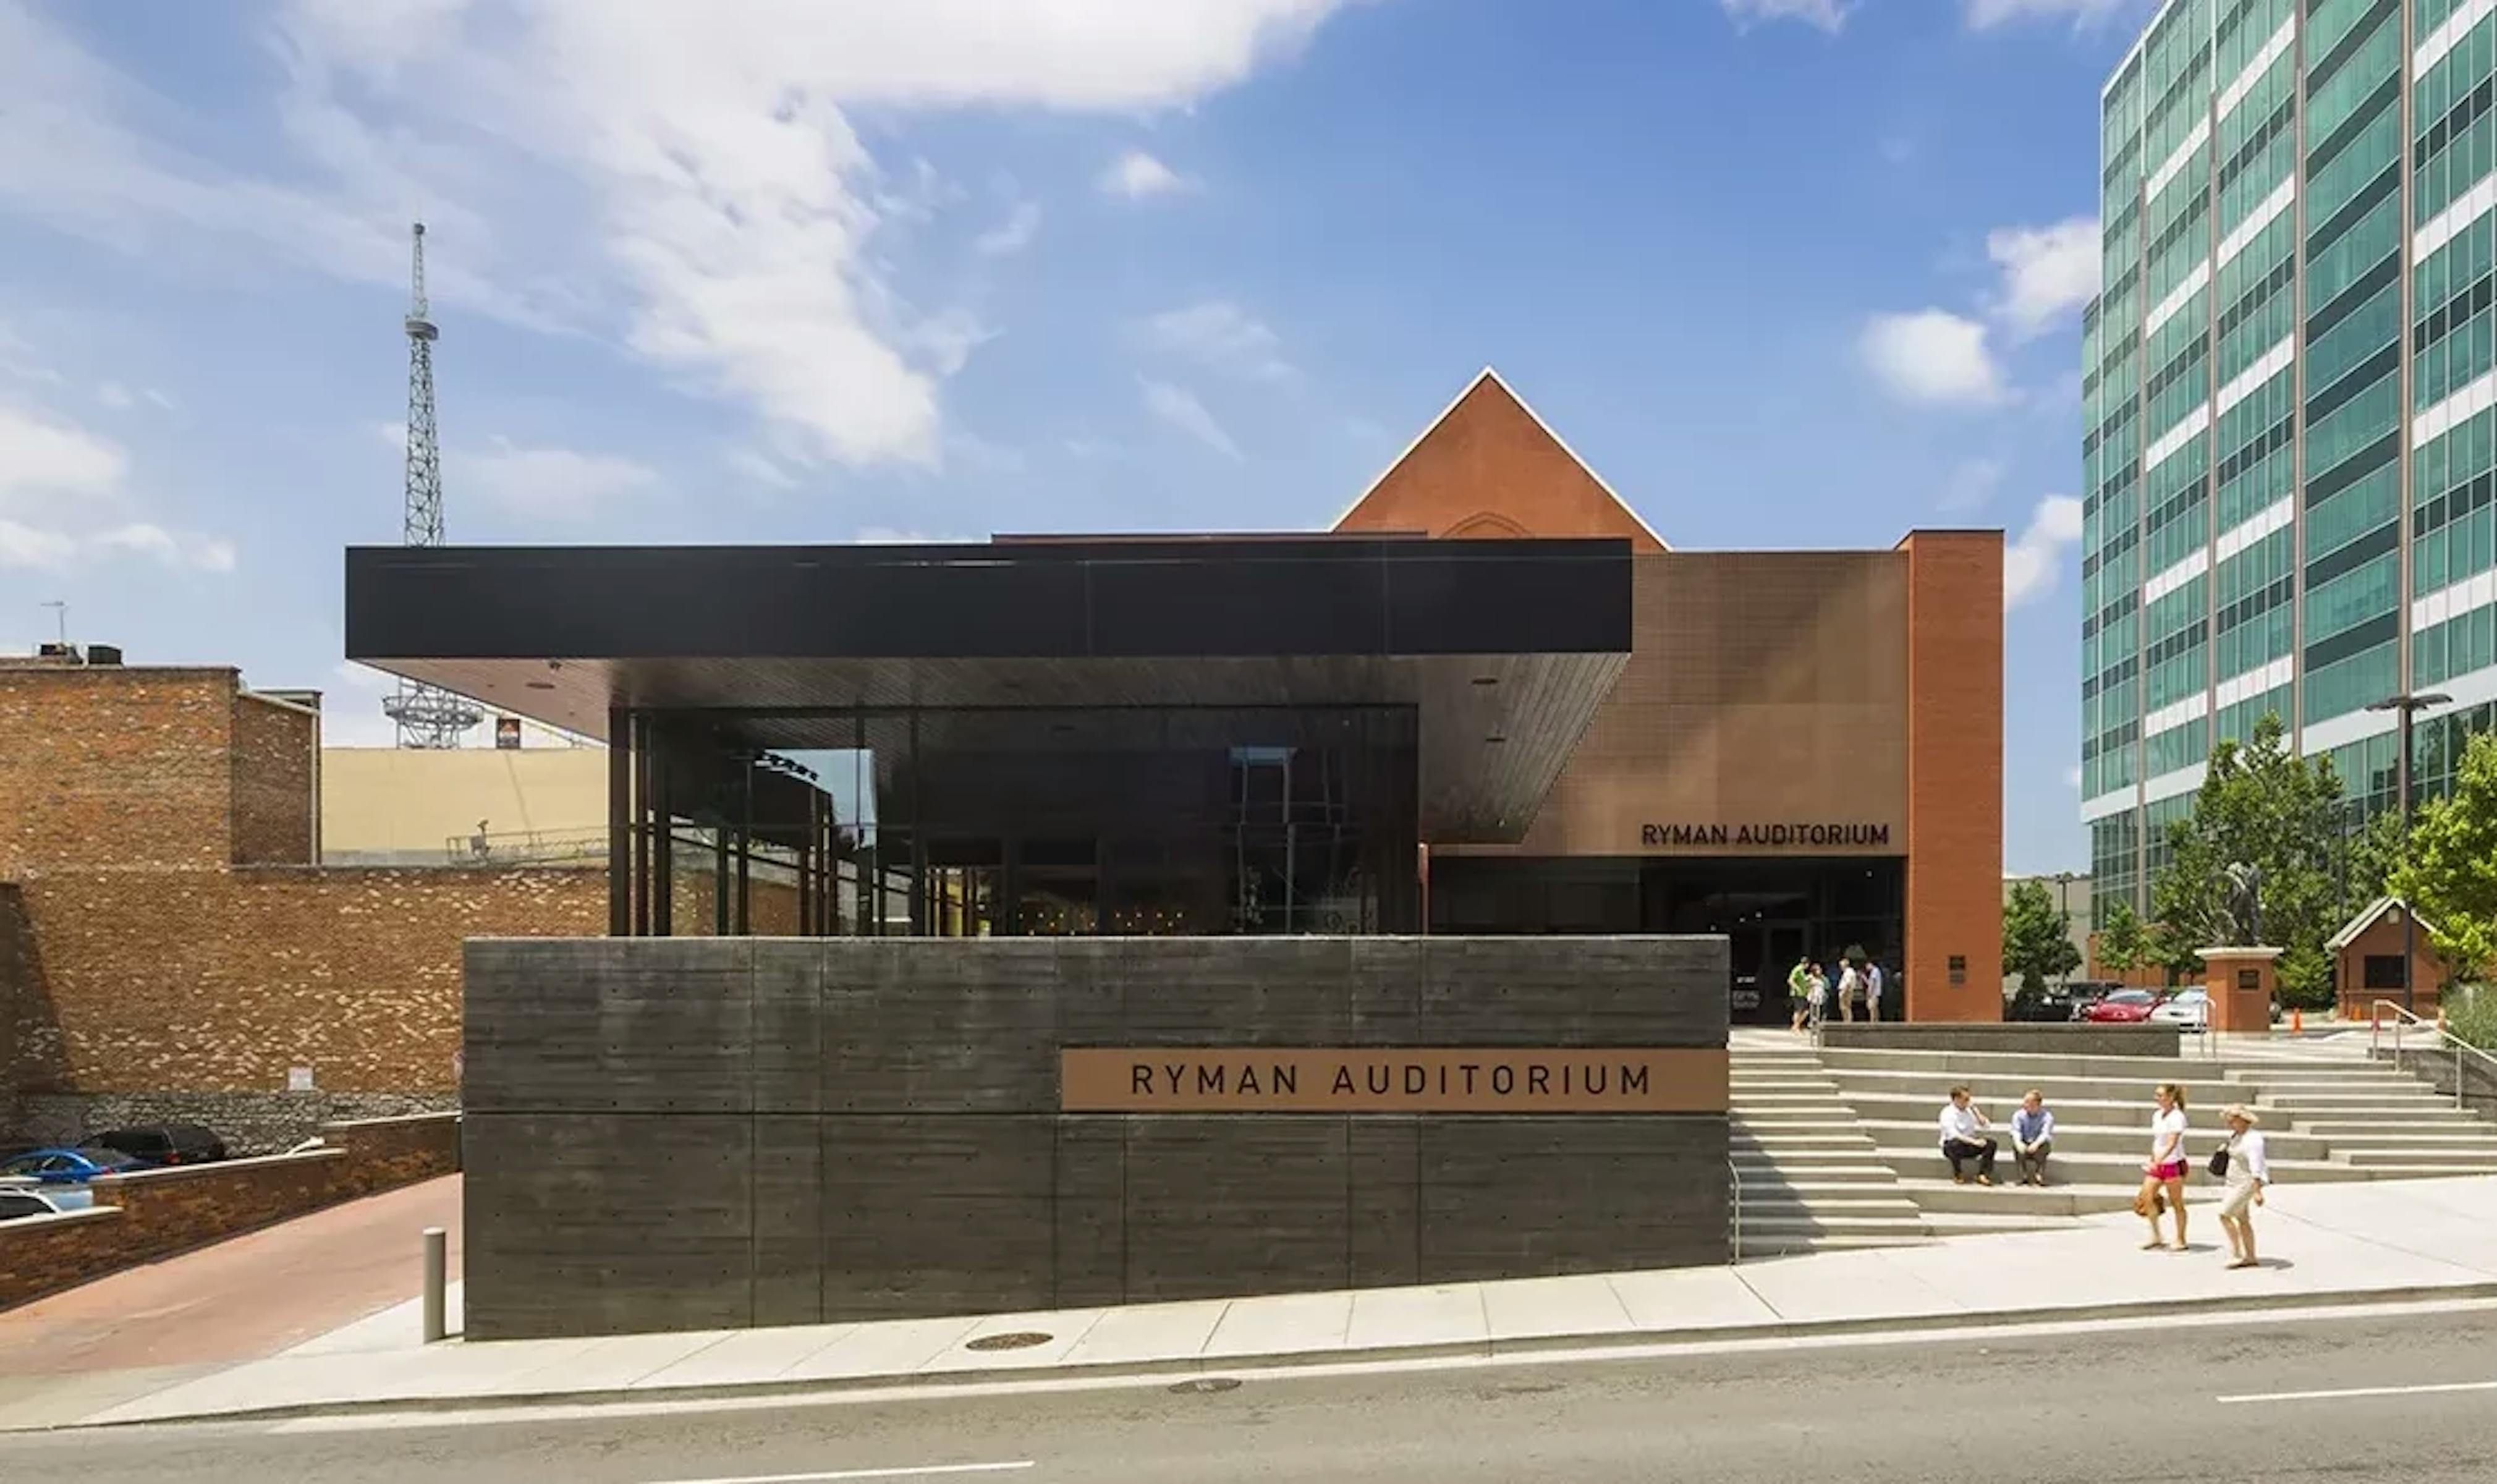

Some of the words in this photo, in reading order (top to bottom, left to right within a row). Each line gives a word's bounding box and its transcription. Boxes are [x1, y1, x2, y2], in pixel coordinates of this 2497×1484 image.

[1642, 824, 1728, 845] RYMAN
[1736, 824, 1888, 846] AUDITORIUM
[1132, 1064, 1296, 1095] RYMAN
[1331, 1064, 1648, 1095] AUDITORIUM
